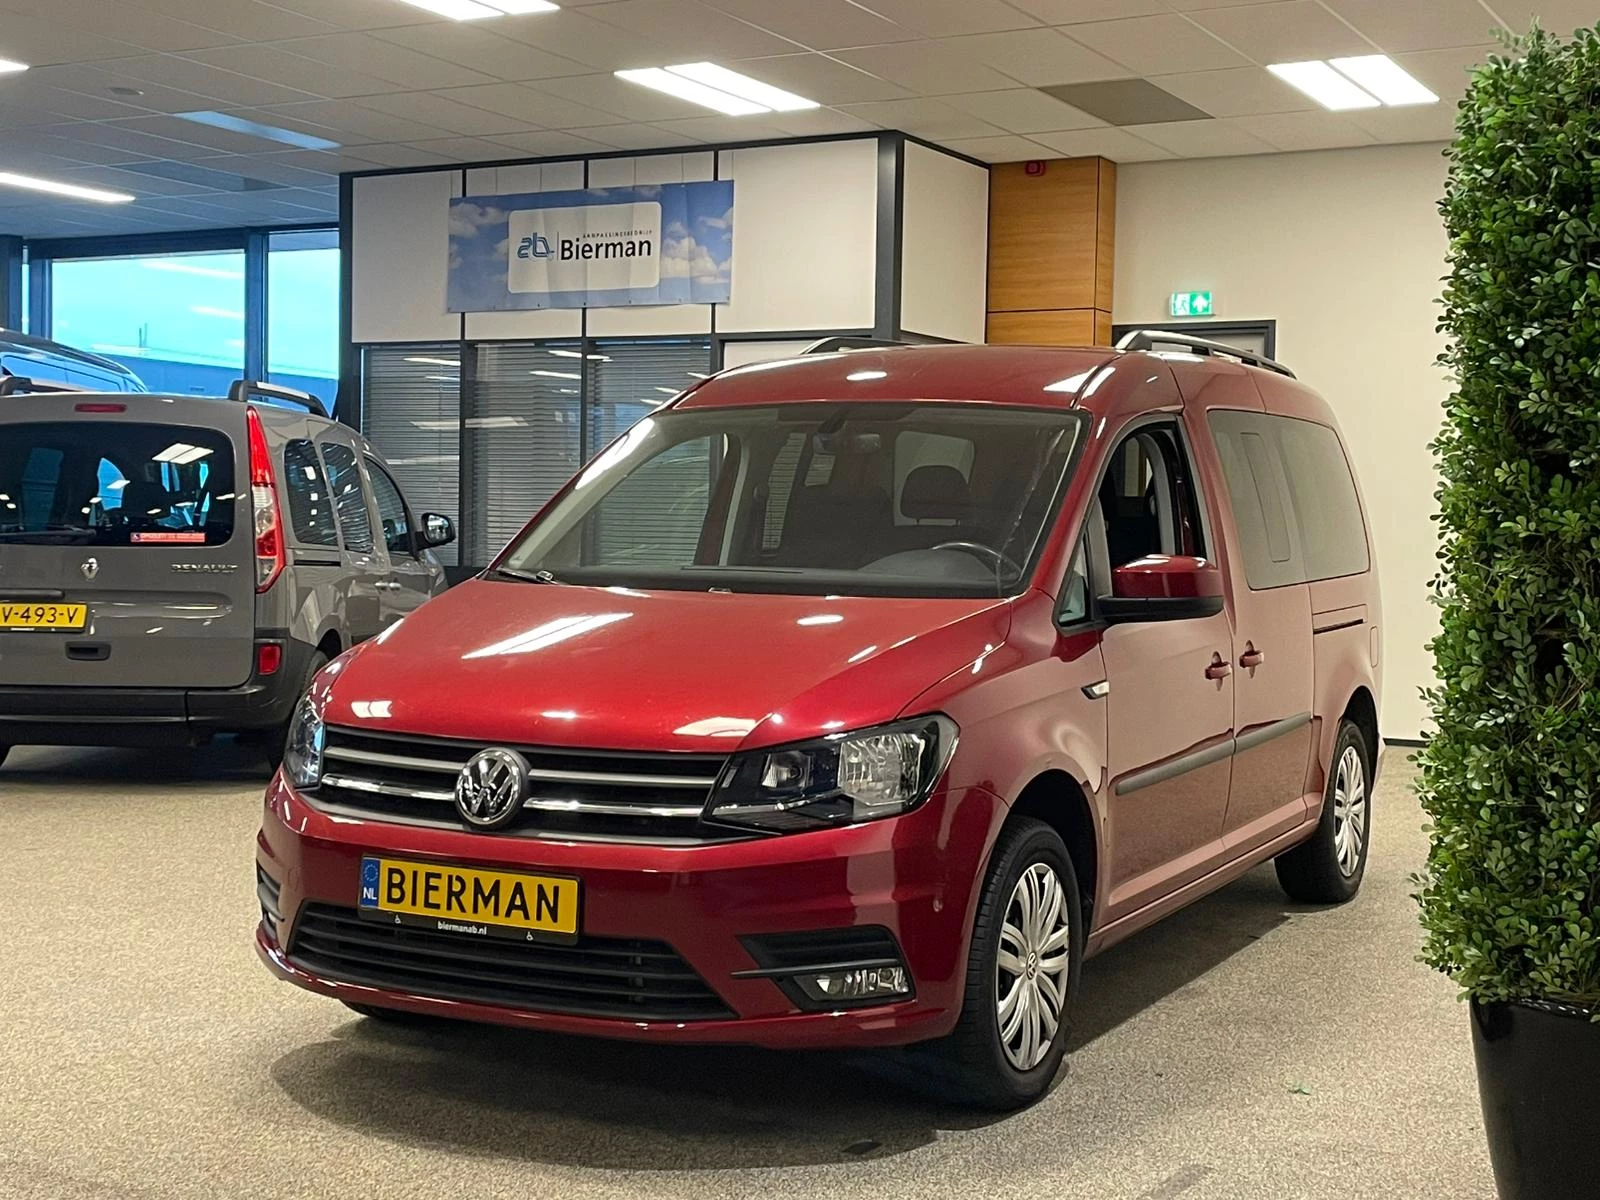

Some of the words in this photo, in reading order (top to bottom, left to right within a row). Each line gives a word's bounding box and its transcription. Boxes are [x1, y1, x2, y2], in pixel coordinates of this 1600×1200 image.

[560, 237, 652, 261] Bierman
[170, 563, 238, 573] RENAULT
[362, 886, 378, 900] NL
[386, 867, 560, 924] BIERMAN
[437, 920, 487, 935] biermanab.nl
